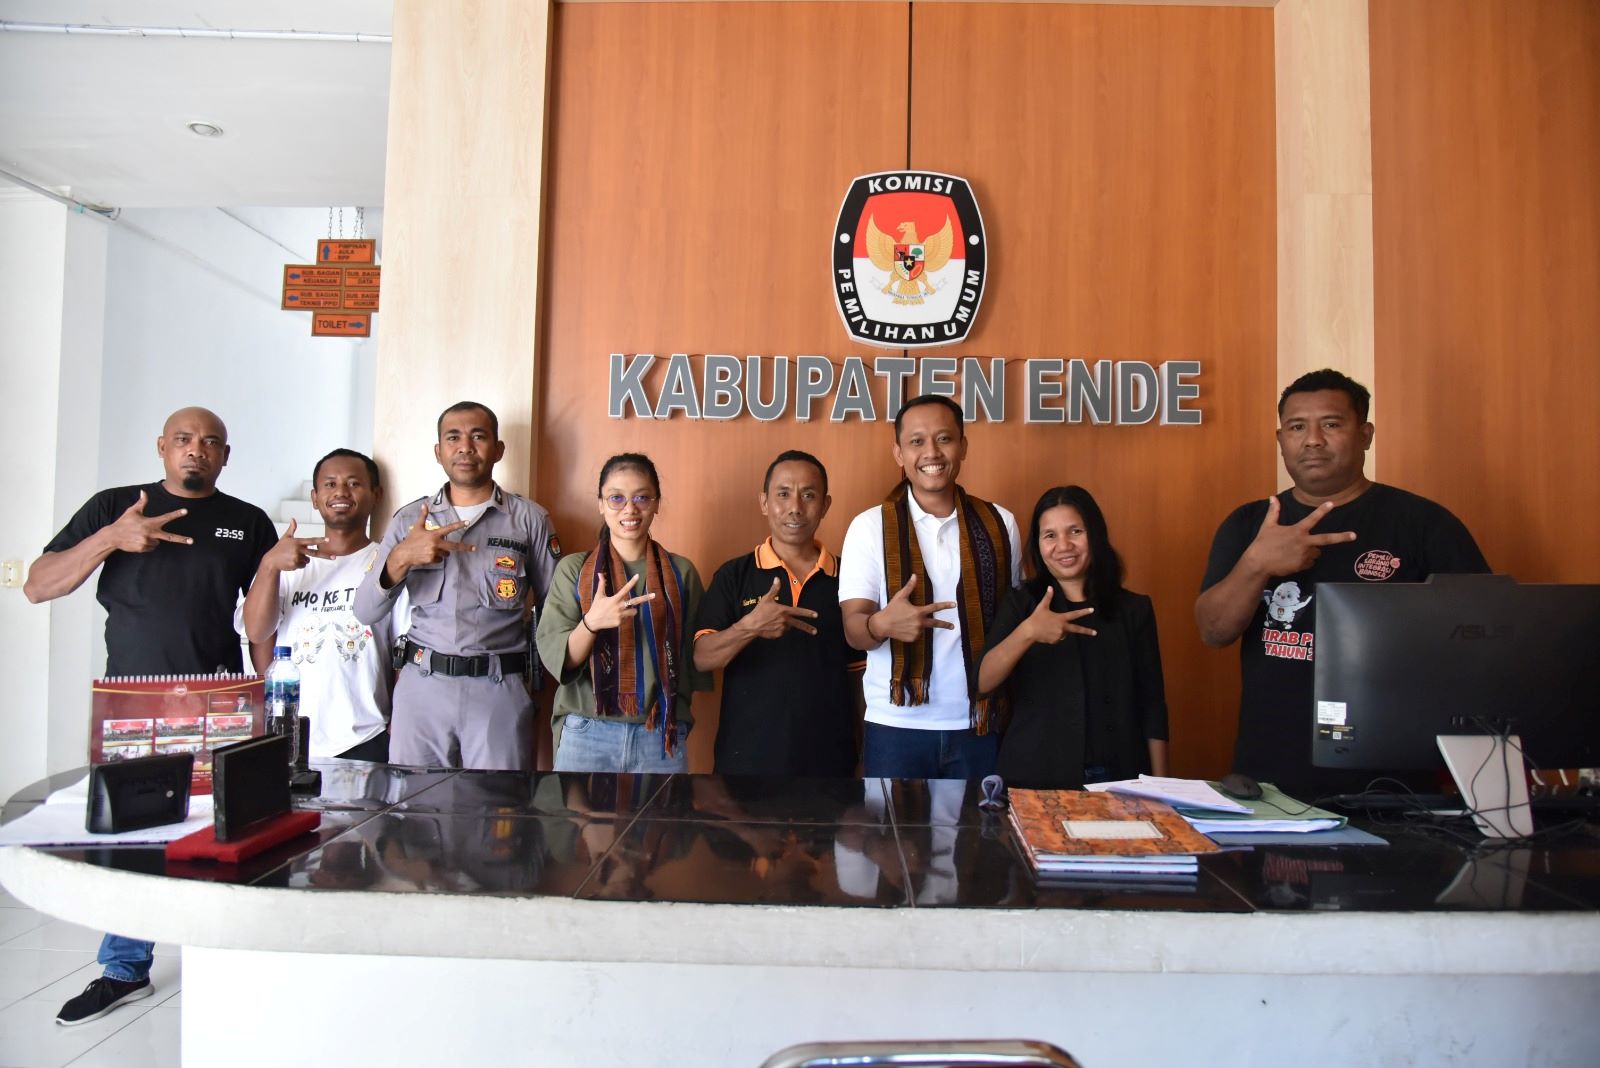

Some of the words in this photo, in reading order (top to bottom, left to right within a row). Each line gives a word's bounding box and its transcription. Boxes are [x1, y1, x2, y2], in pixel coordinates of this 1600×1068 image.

[868, 175, 954, 195] KOMISI
[838, 269, 936, 340] PEMILIHAN
[943, 269, 981, 336] UMUM
[318, 320, 348, 329] TOILET
[608, 353, 1005, 422] KABUPATEN
[1024, 358, 1202, 426] ENDE
[215, 527, 244, 540] 23:59
[487, 537, 528, 555] KEAMANAN
[1364, 558, 1390, 567] SARANA
[1367, 552, 1391, 561] PEMILU
[1357, 563, 1392, 574] INTEGRASI
[1358, 568, 1386, 578] BANGSA
[291, 591, 318, 608] AYO
[322, 590, 339, 606] KE
[1265, 643, 1308, 660] TAHUN
